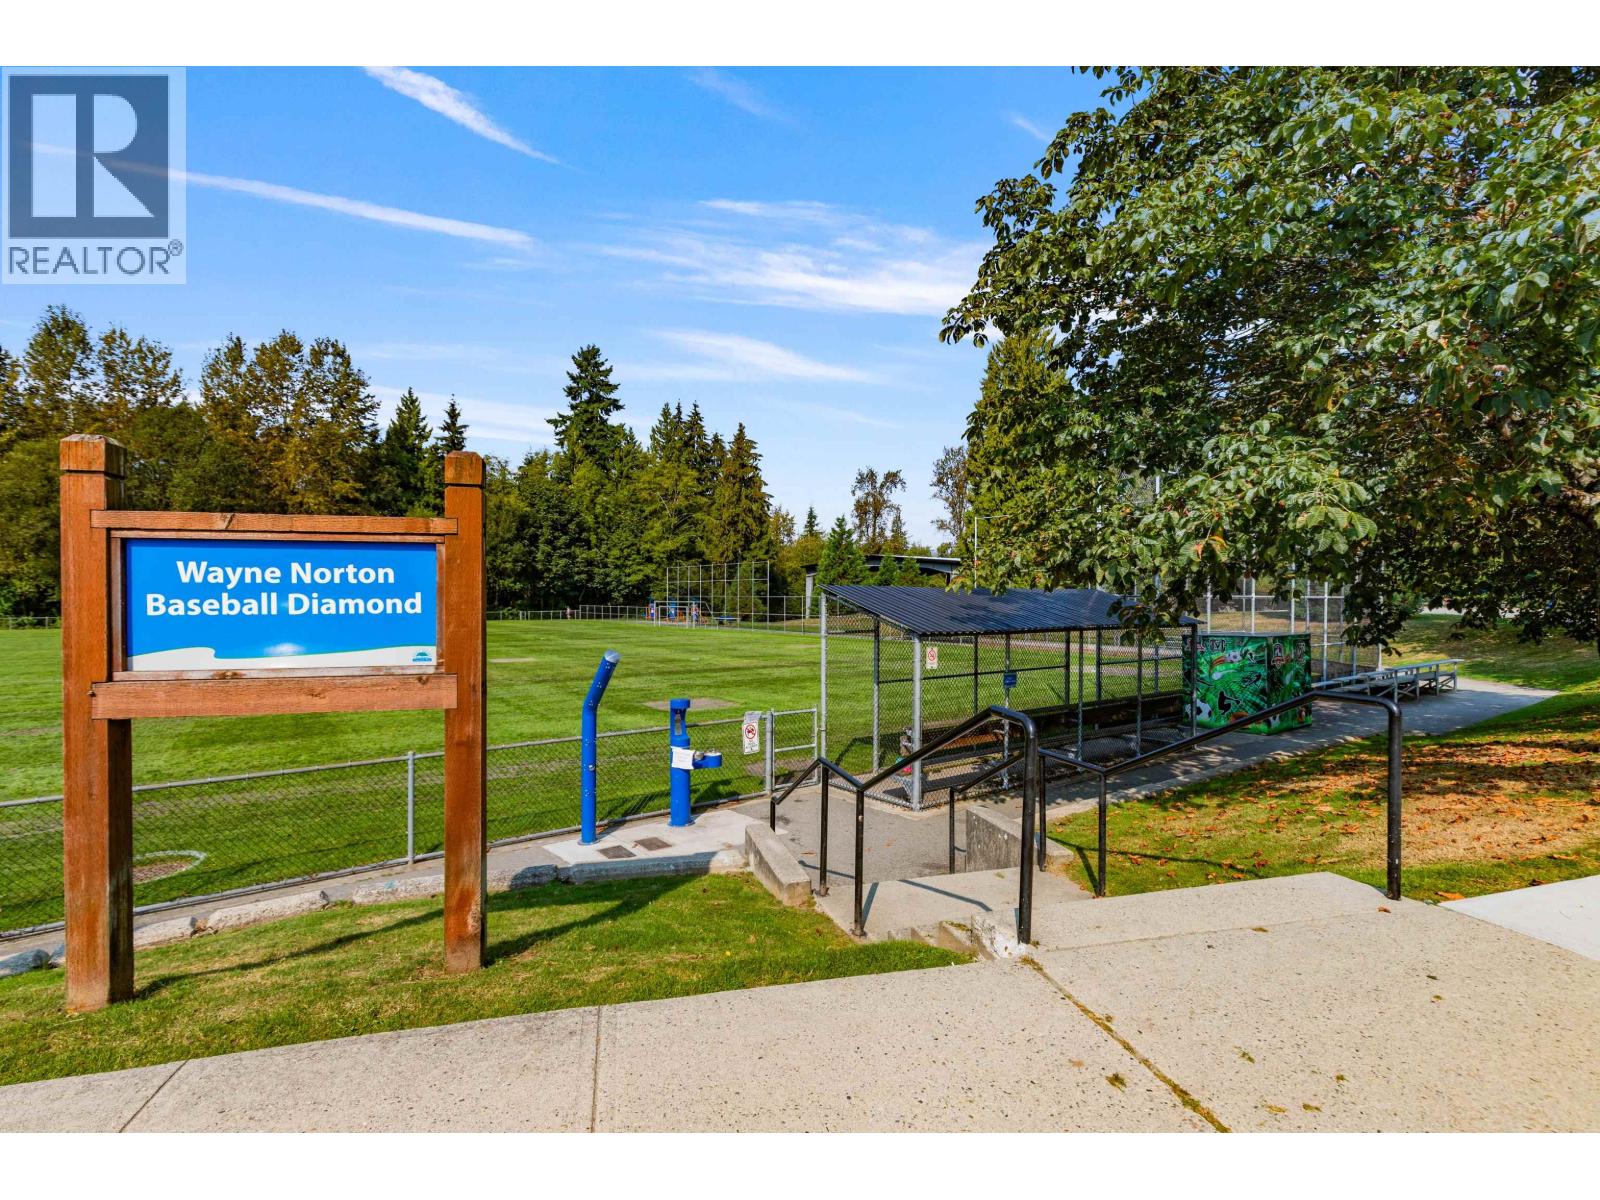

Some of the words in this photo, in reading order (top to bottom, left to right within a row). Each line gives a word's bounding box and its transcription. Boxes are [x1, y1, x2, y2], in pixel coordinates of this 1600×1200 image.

[176, 560, 282, 590] Wayne
[291, 562, 395, 584] Norton
[146, 592, 278, 616] Baseball
[288, 592, 422, 615] Diamond
